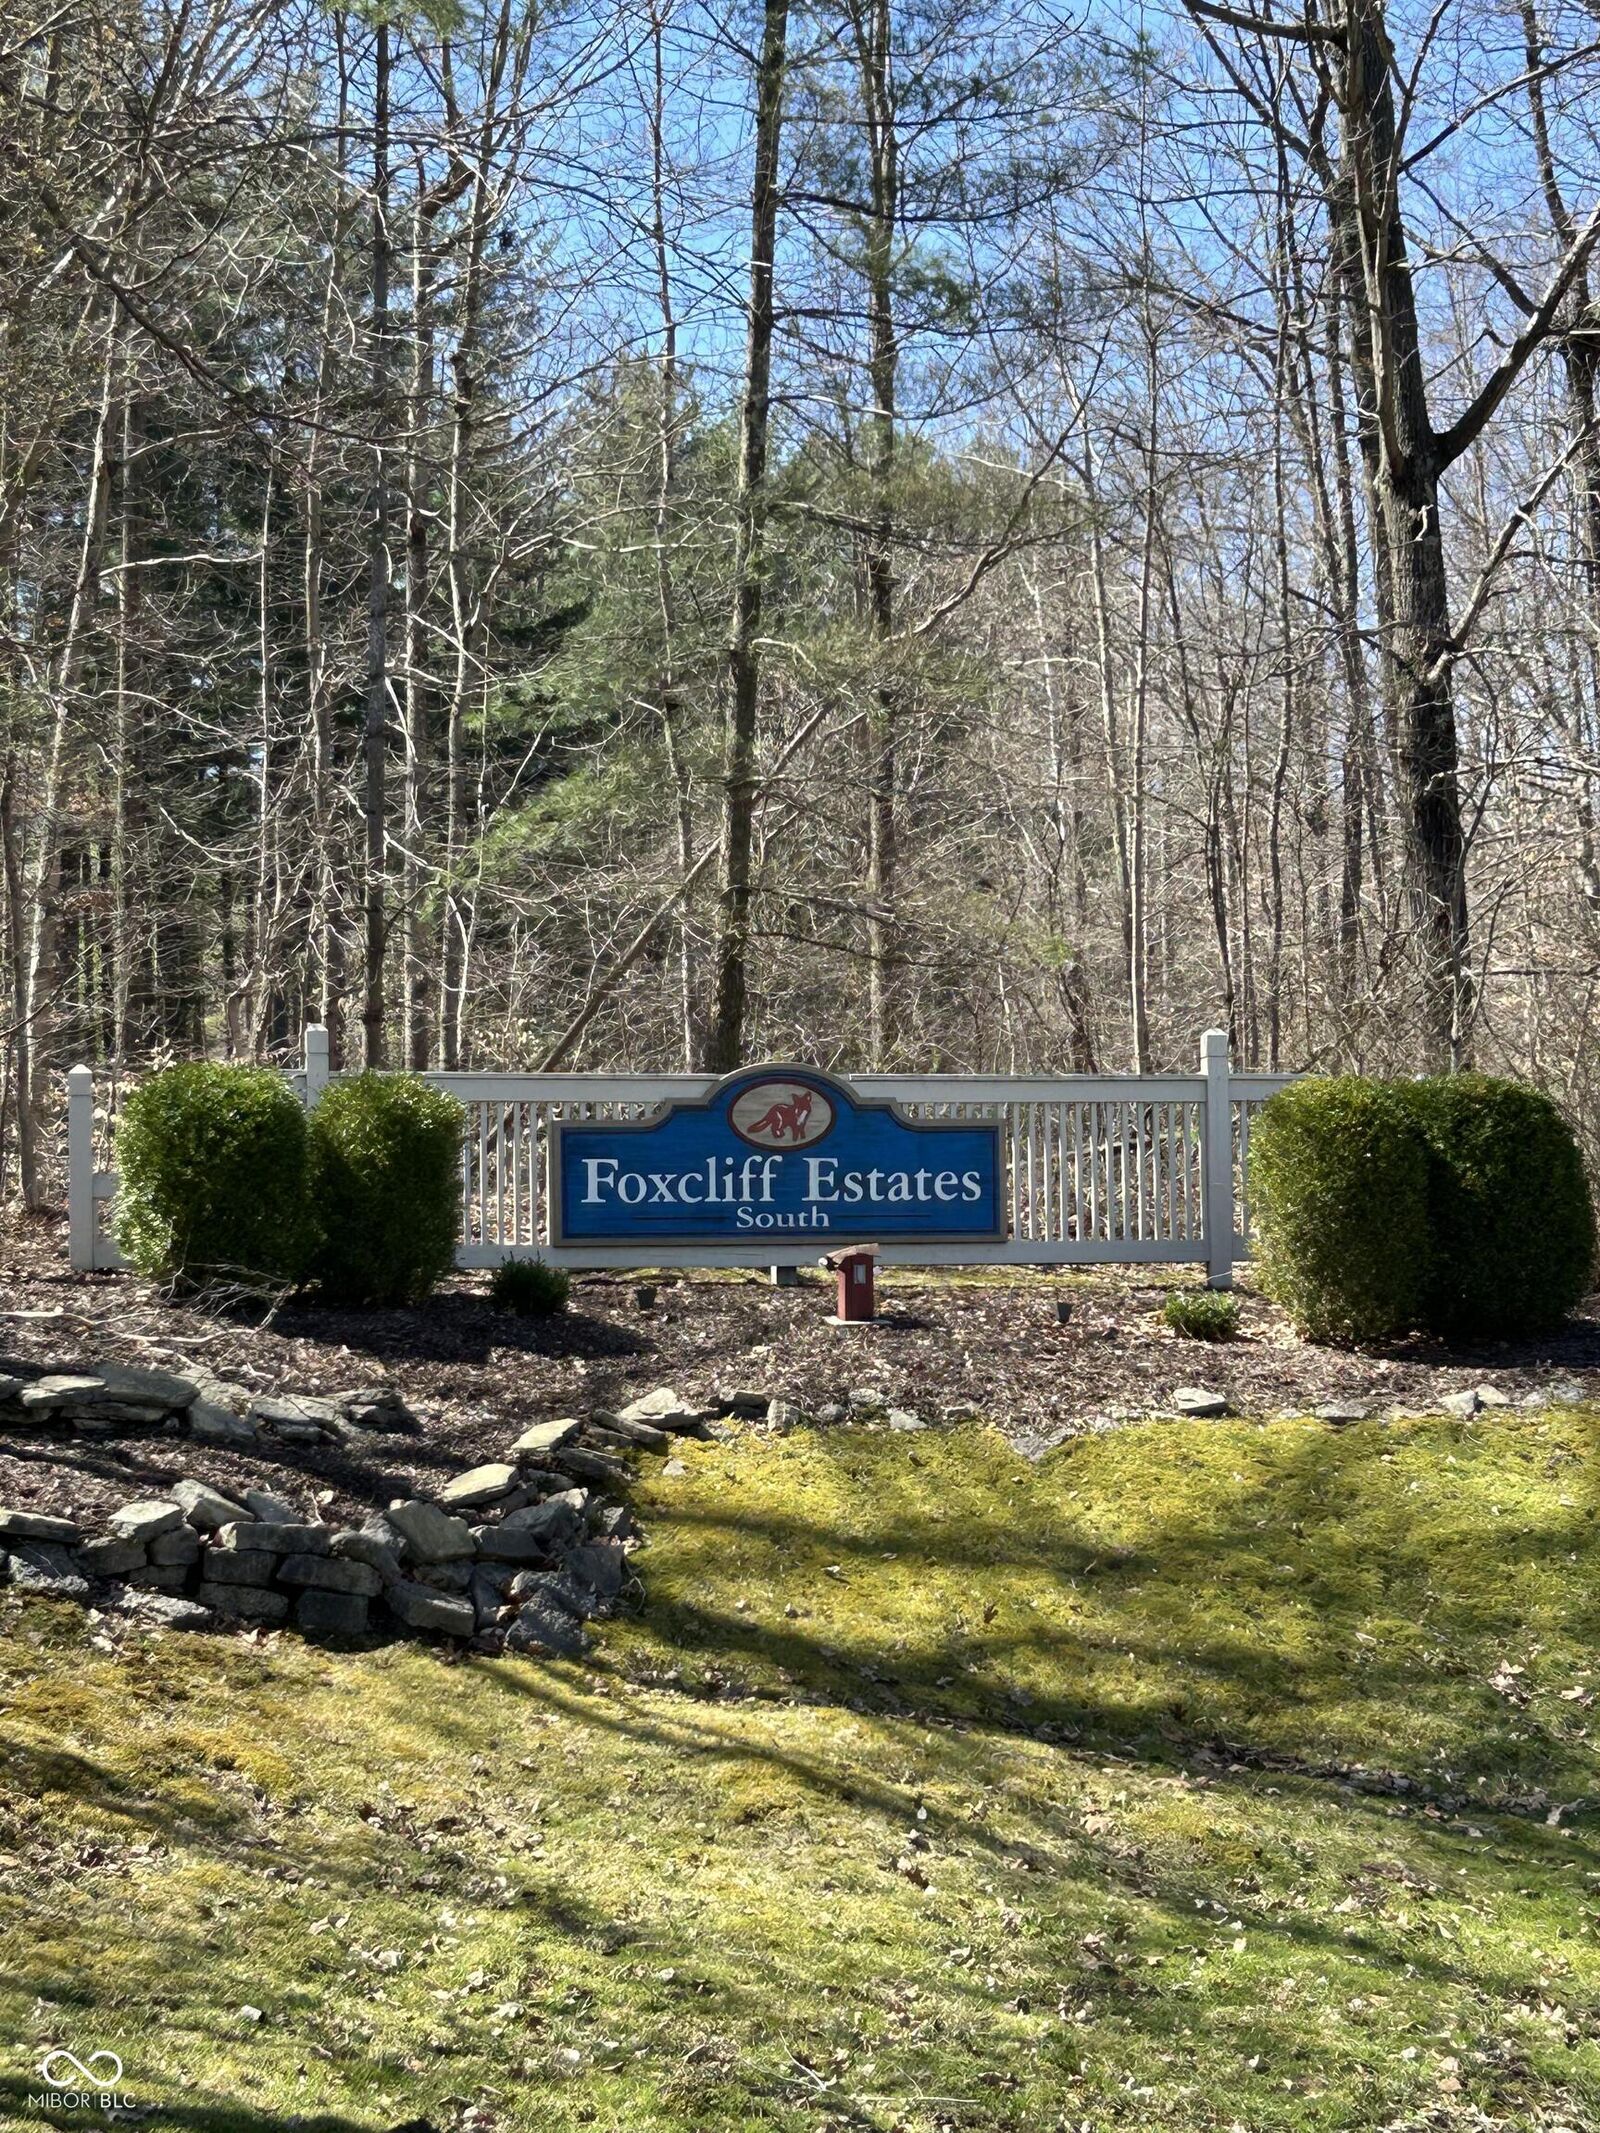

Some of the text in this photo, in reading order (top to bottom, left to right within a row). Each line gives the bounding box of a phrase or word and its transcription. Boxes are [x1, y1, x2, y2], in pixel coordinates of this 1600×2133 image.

[581, 1155, 982, 1204] Foxcliff Estates
[736, 1206, 830, 1229] South
